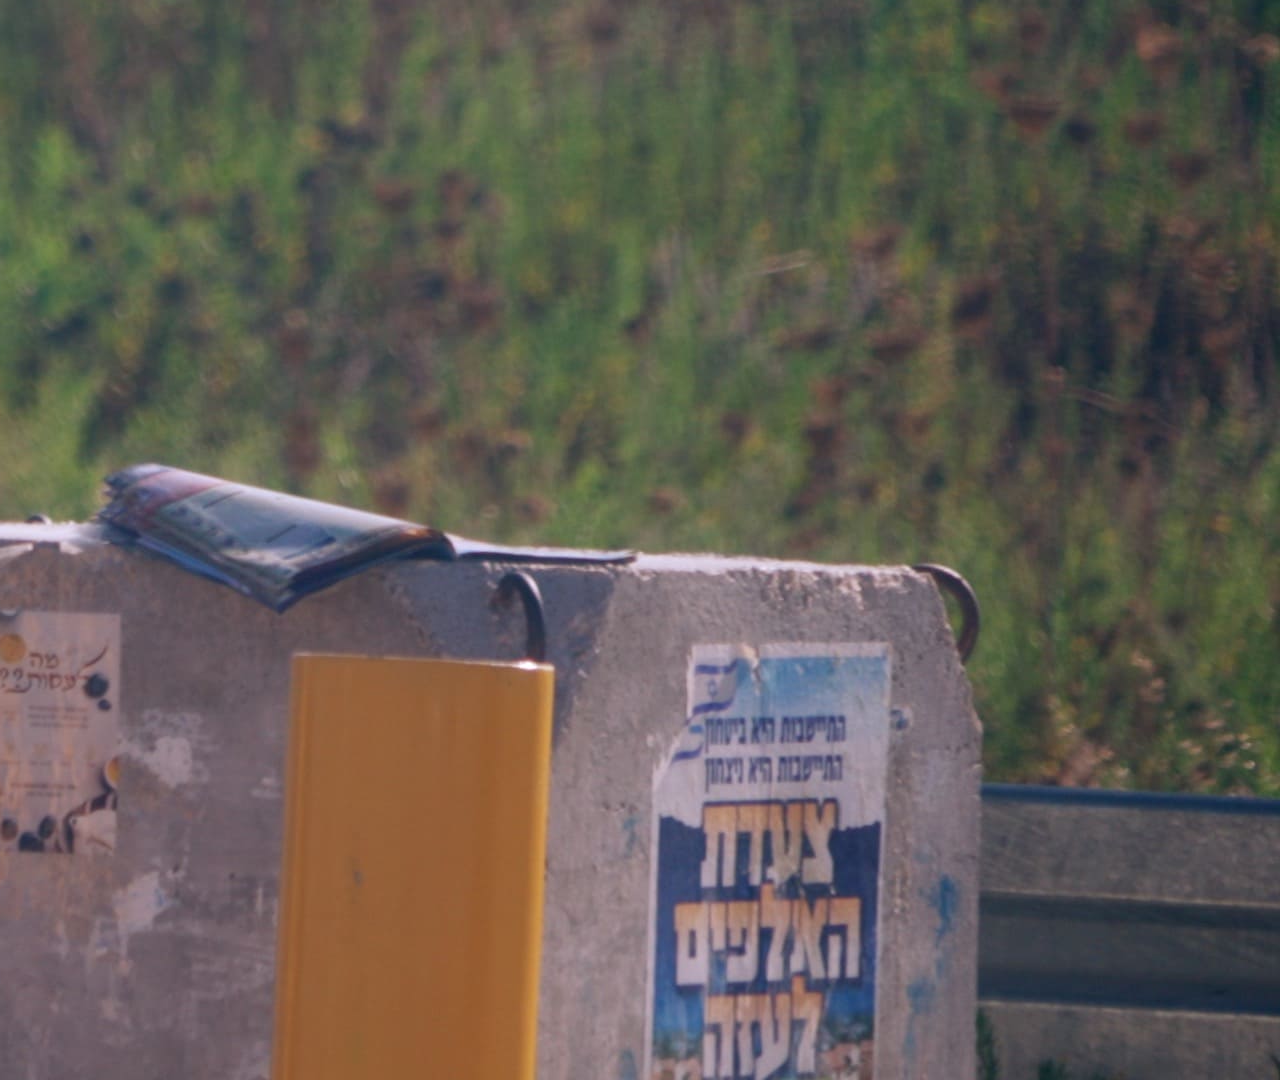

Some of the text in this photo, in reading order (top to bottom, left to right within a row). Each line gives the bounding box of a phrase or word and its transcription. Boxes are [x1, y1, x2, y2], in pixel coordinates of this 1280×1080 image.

[29, 652, 59, 670] מה
[704, 714, 846, 754] התיישבות היא ביטחון
[704, 754, 843, 794] התיישבות היא ניצחון
[700, 798, 839, 888] צעדת
[673, 881, 863, 986] האלפים
[702, 974, 825, 1080] לעזה
